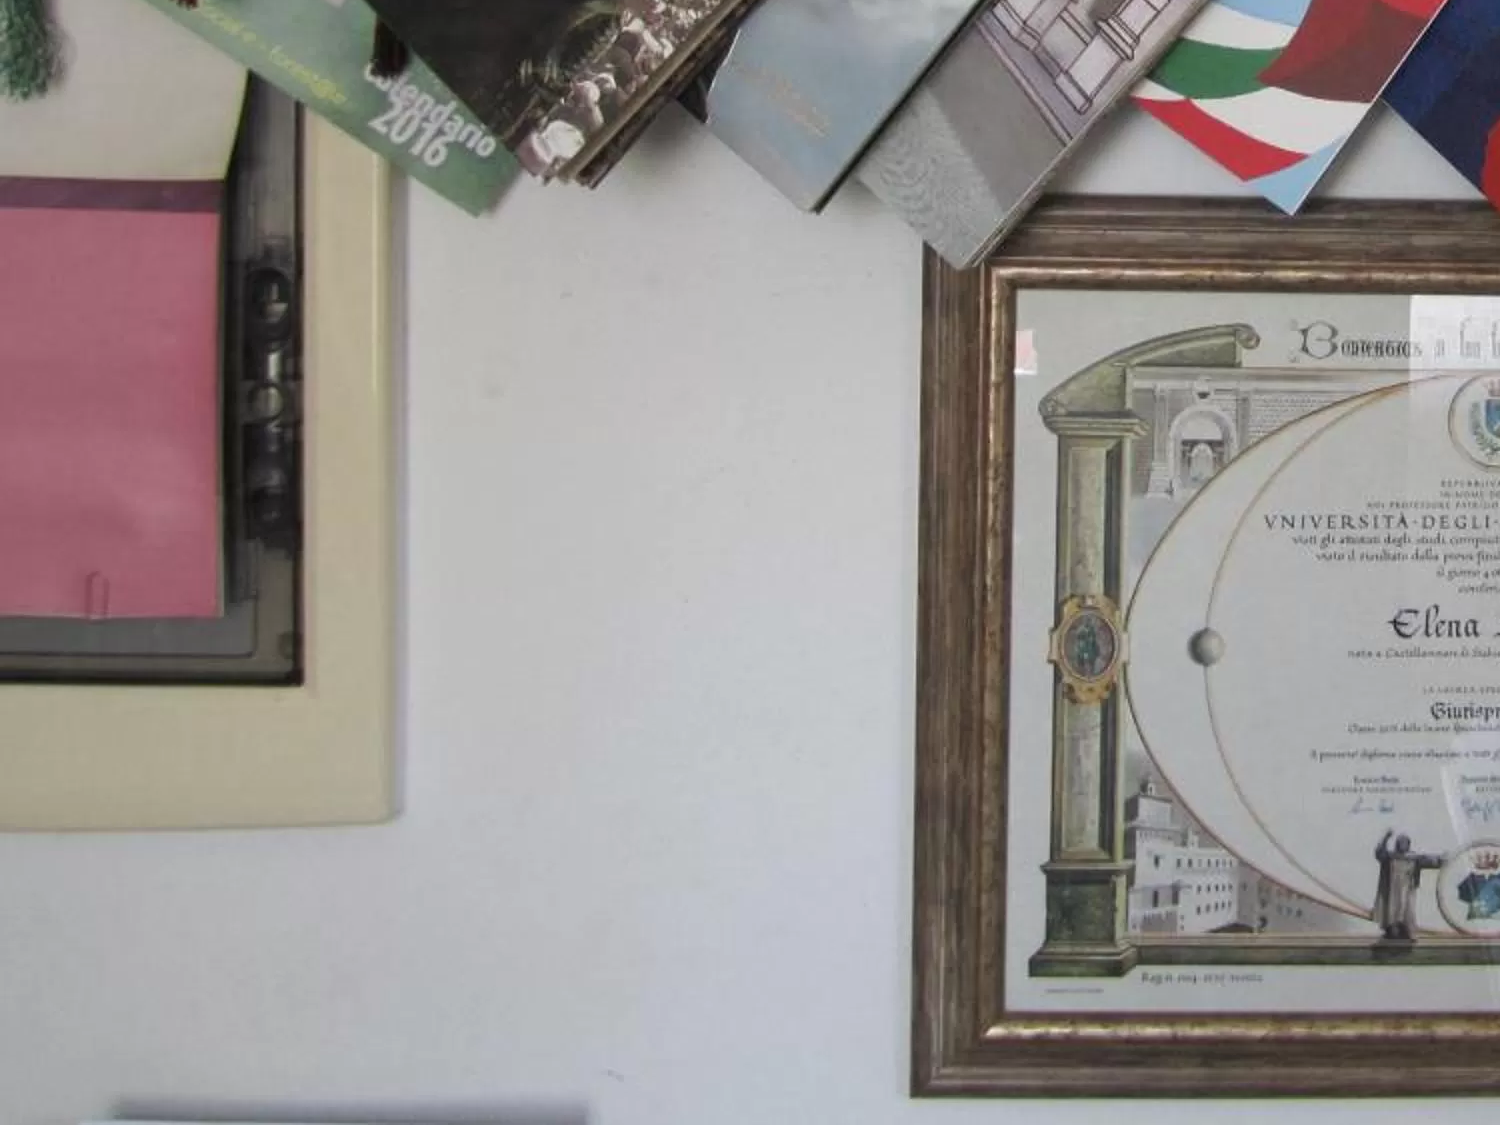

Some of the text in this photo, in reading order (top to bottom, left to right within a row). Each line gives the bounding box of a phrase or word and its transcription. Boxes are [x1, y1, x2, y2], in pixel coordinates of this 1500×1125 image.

[367, 97, 449, 167] 2016
[1421, 513, 1490, 530] DEGLI
[1386, 603, 1481, 639] Elena
